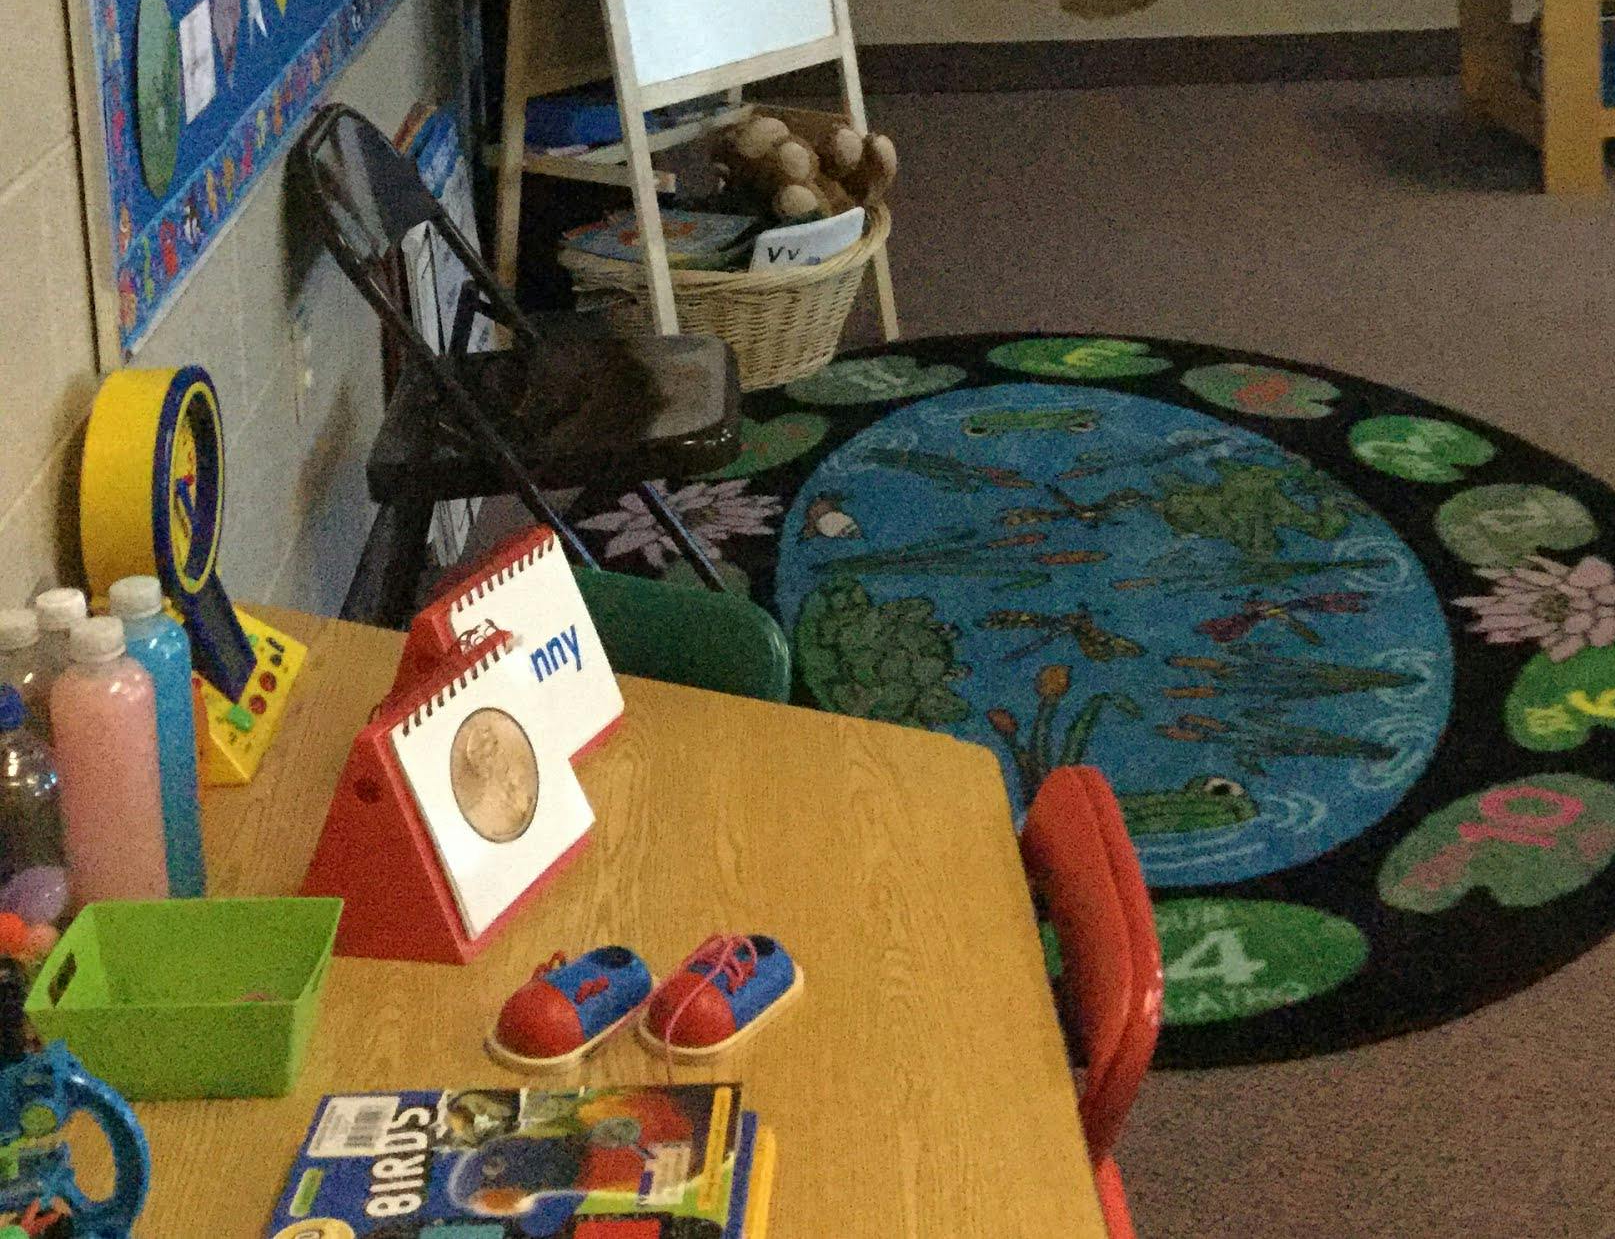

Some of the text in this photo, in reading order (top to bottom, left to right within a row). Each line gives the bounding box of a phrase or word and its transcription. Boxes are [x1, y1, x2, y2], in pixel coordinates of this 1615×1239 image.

[529, 624, 582, 683] nny
[1456, 785, 1585, 850] 10
[1164, 928, 1267, 985] 4
[365, 1105, 432, 1217] BIRDS
